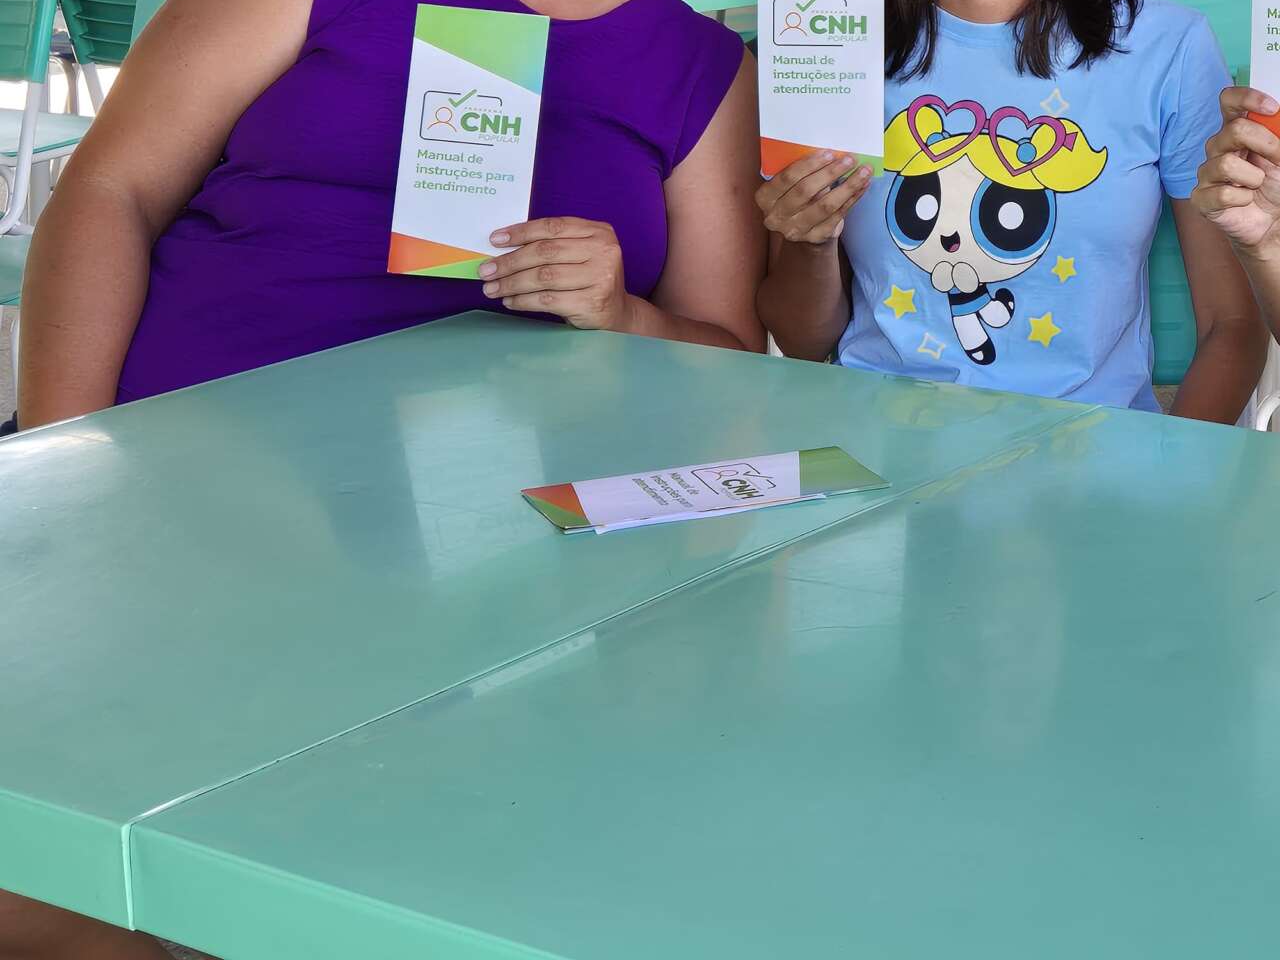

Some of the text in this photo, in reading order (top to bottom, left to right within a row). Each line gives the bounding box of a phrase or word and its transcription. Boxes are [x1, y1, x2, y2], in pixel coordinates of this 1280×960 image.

[809, 15, 868, 34] CNH
[773, 55, 835, 65] Manual de
[773, 69, 866, 82] instruções para
[773, 84, 851, 94] atendimento
[460, 112, 522, 136] CNH
[417, 149, 483, 164] Manual de
[415, 163, 515, 182] instruções para
[414, 180, 497, 195] atendimento
[721, 478, 765, 500] CNH
